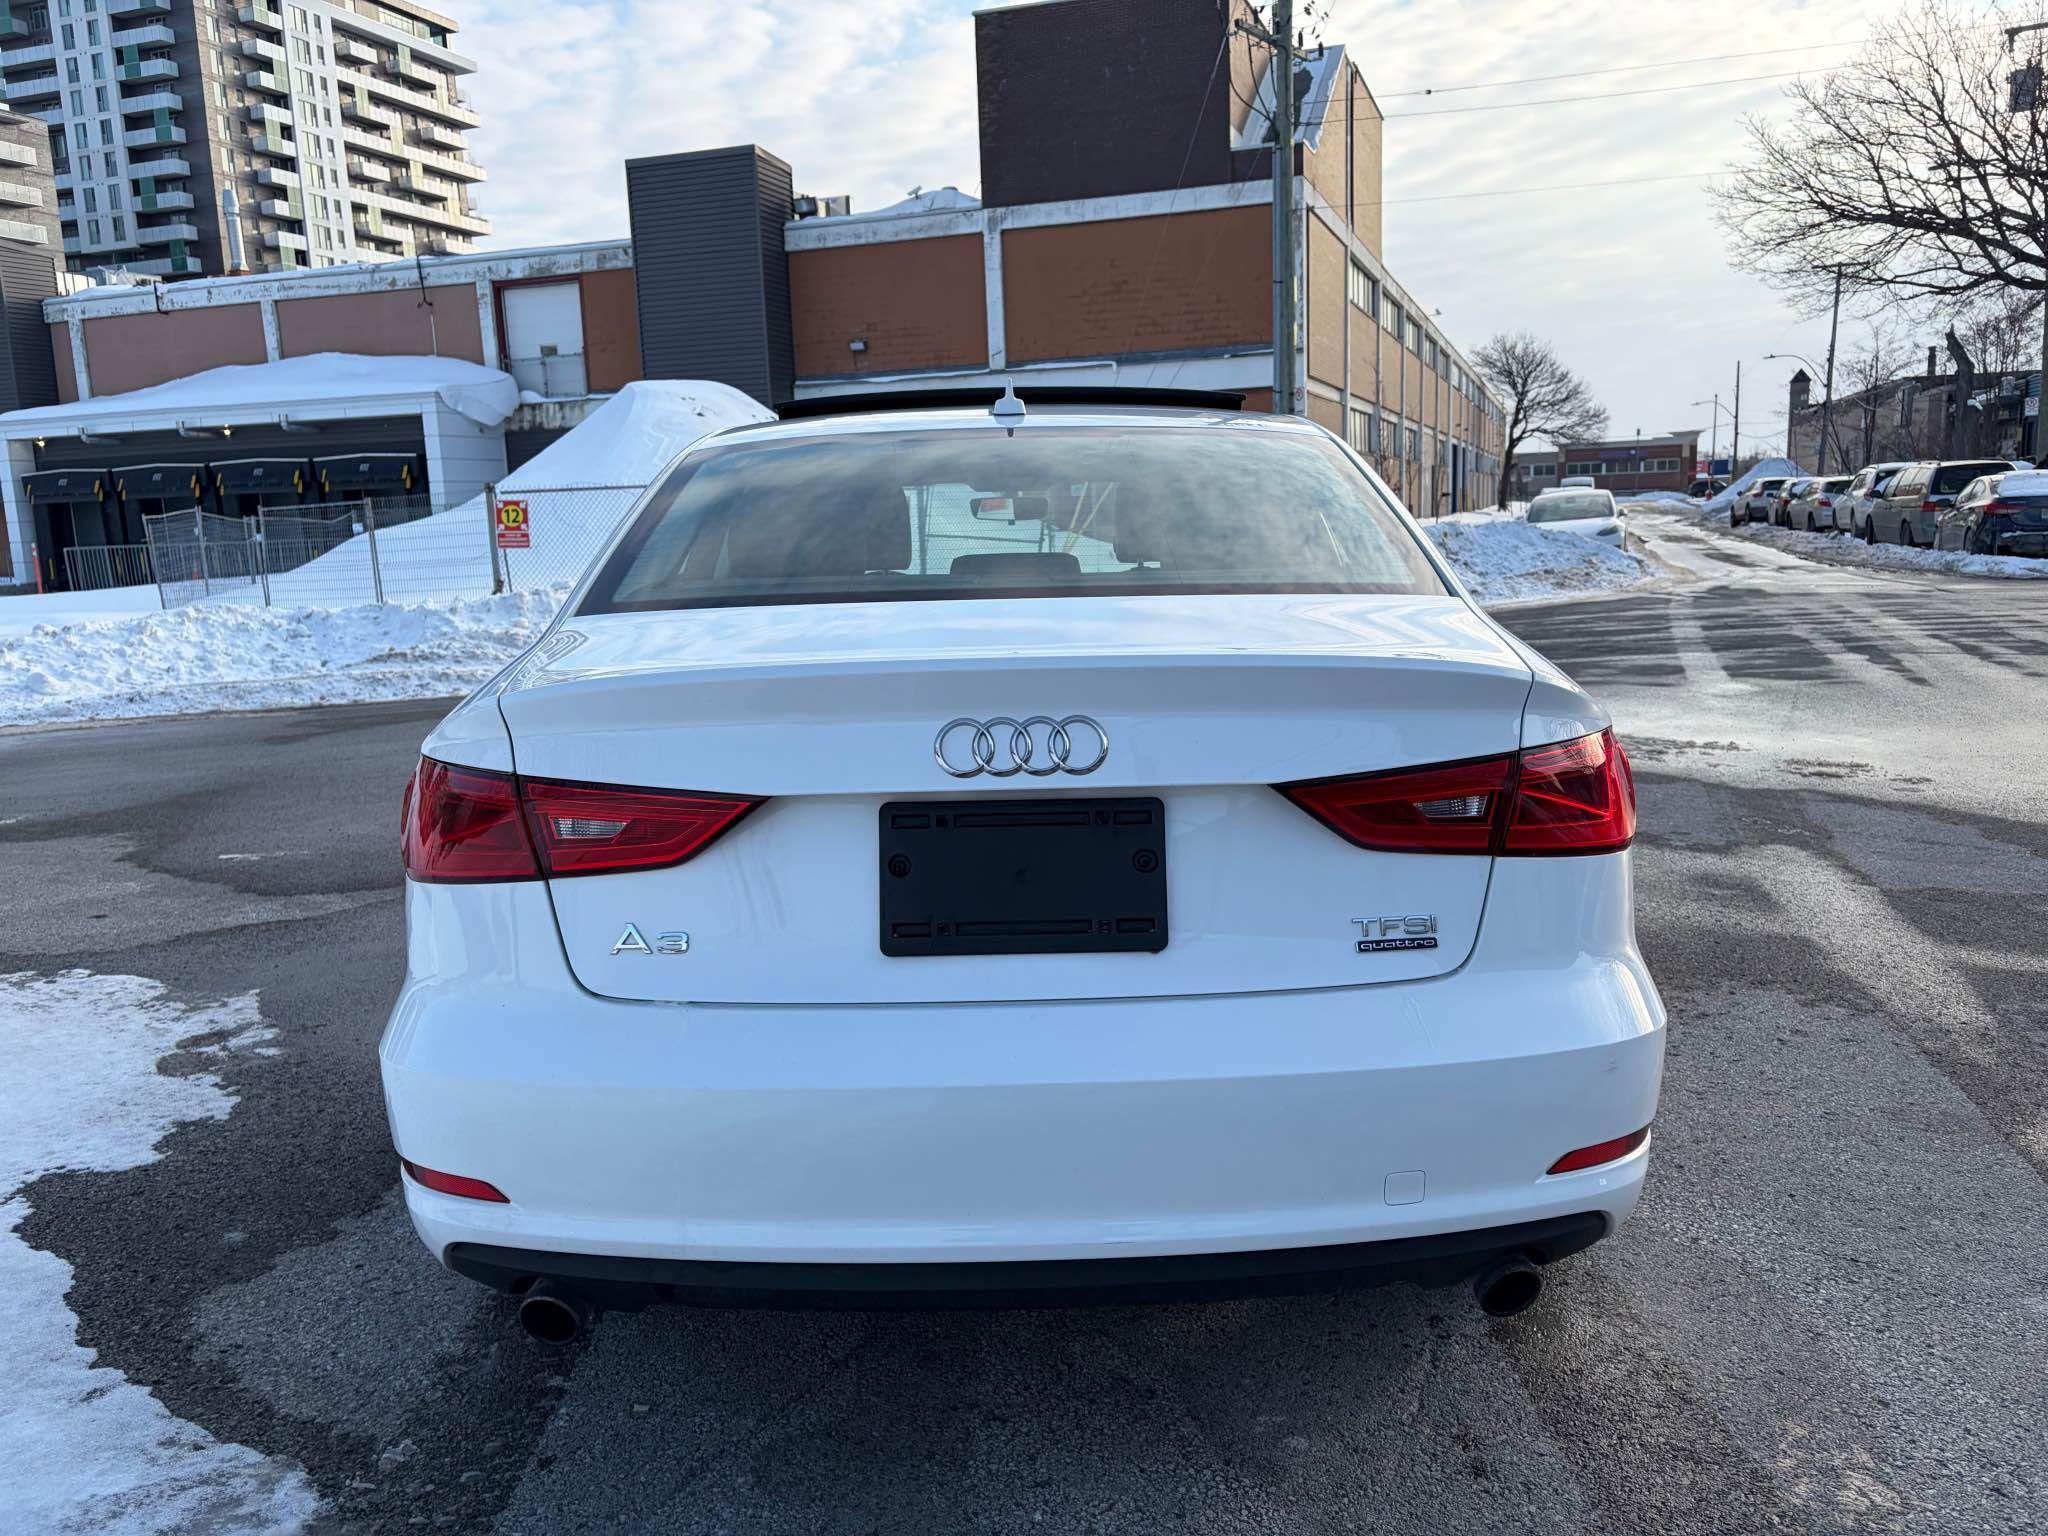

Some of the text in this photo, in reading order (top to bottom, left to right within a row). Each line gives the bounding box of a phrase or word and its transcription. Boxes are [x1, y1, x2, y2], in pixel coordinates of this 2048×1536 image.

[504, 508, 521, 524] 12
[1351, 914, 1438, 937] TFSI
[610, 922, 690, 955] A3
[1359, 938, 1436, 952] quattro
